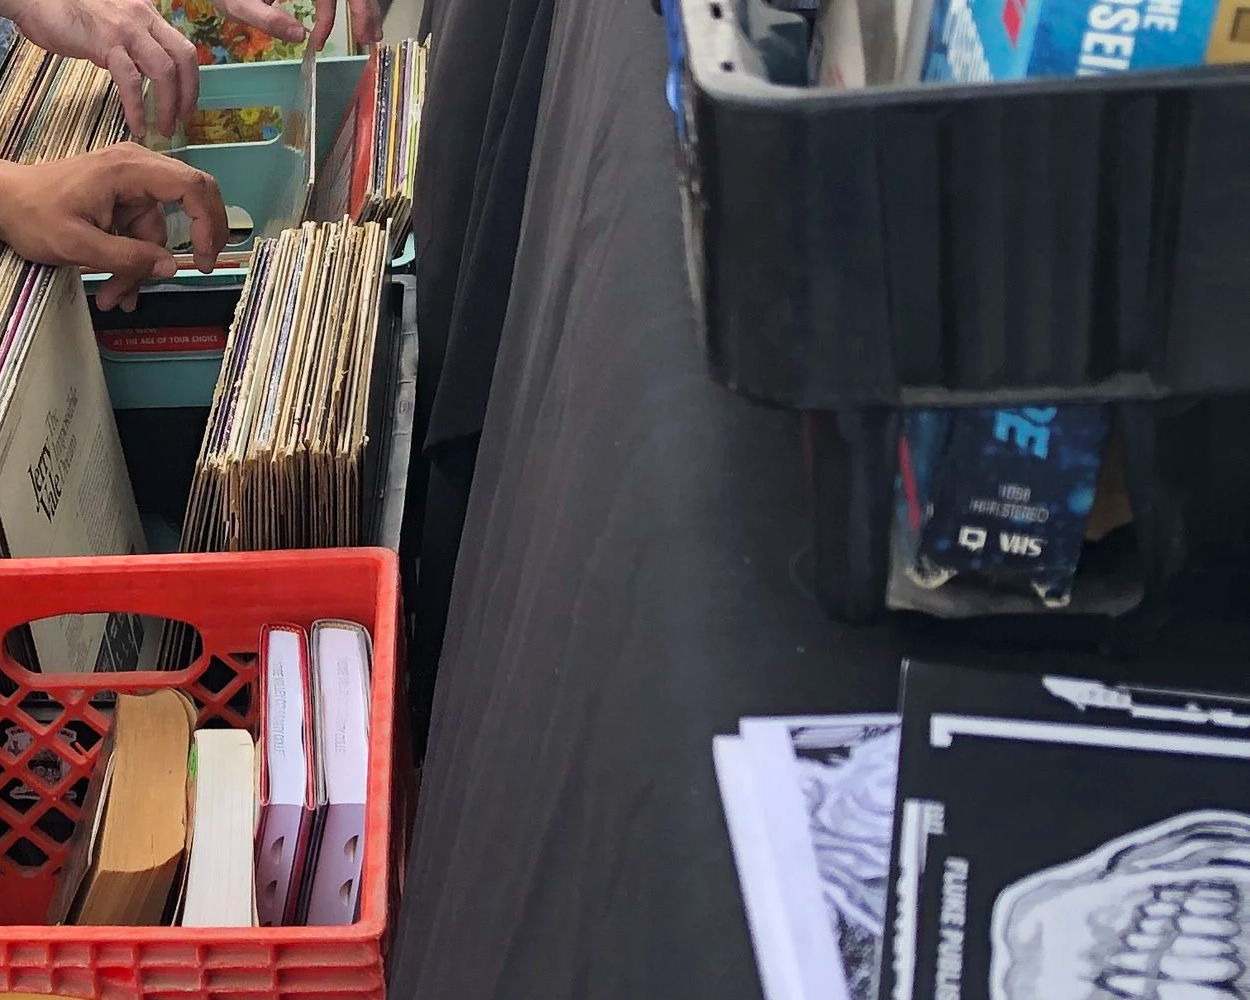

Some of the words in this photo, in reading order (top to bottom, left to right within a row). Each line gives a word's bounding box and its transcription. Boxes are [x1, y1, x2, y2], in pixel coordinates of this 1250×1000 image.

[192, 335, 218, 343] CHOICE
[27, 436, 54, 513] Jerry
[1000, 532, 1048, 558] VHS
